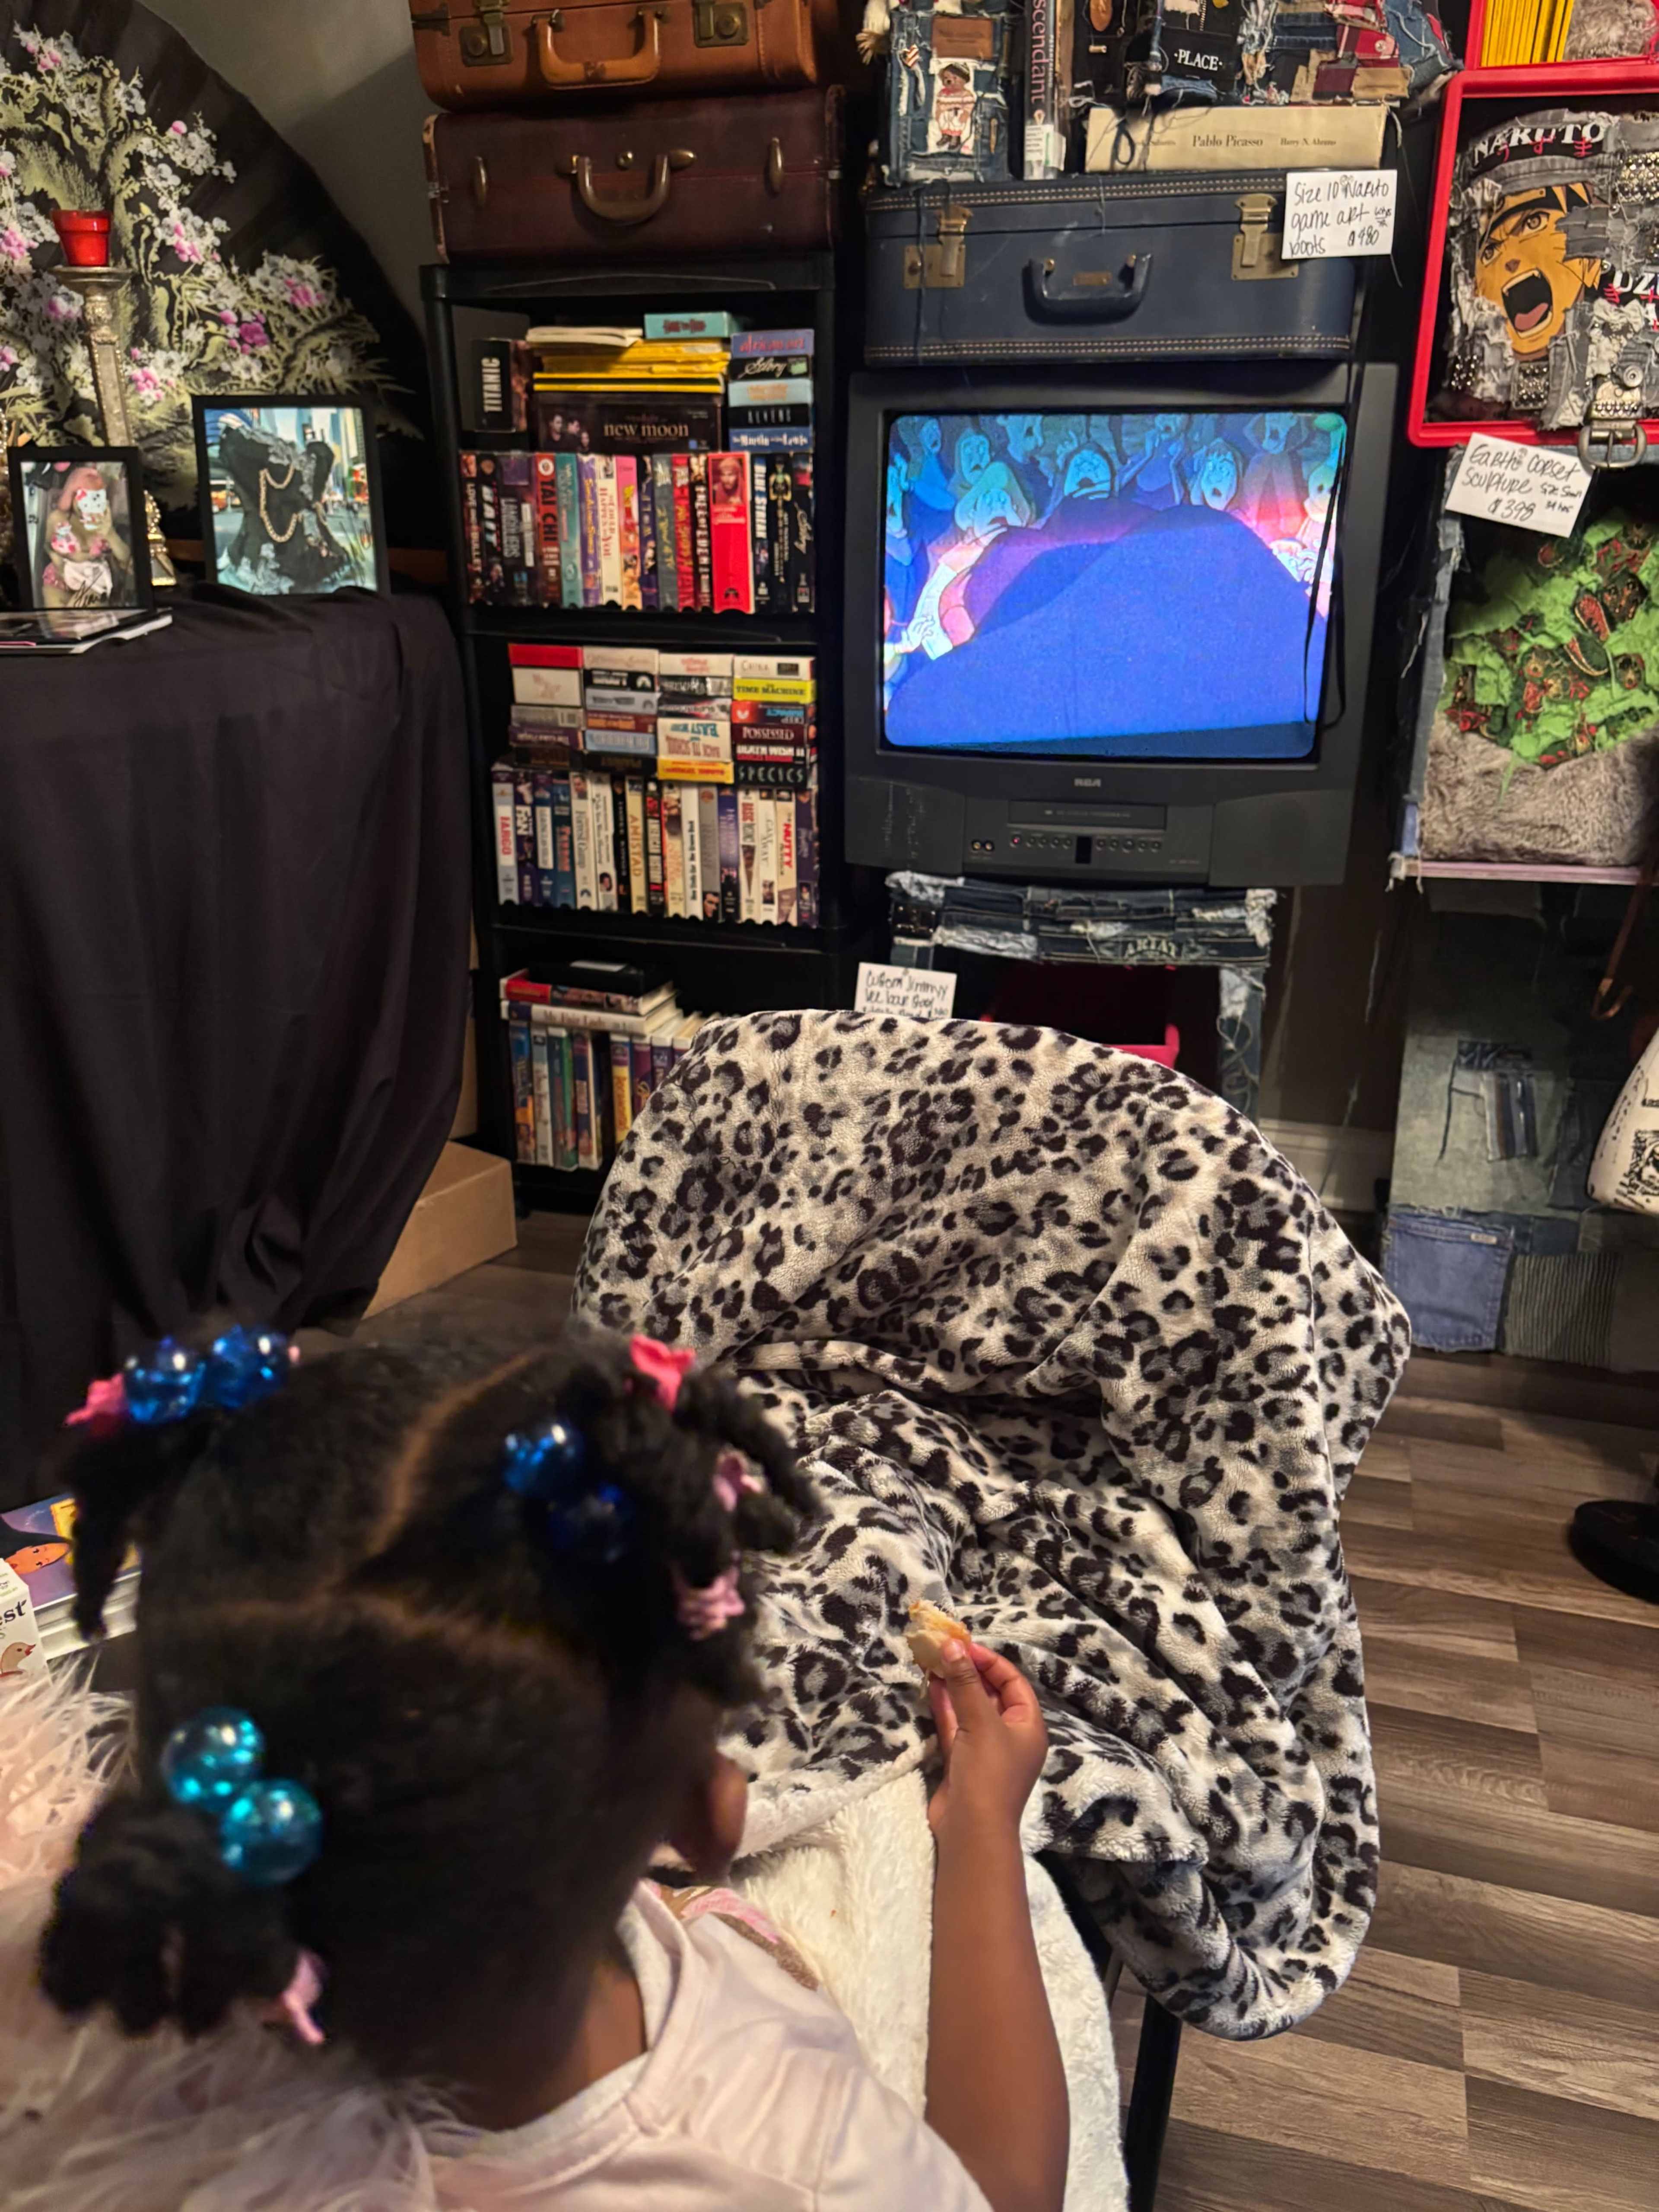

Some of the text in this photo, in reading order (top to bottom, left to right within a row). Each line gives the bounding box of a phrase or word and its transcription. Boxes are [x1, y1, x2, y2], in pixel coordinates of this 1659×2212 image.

[1177, 48, 1219, 71] PLACE
[1192, 134, 1264, 147] Pablo Picasso
[1474, 123, 1607, 166] NARUTO
[1294, 181, 1322, 206] Size
[1327, 181, 1339, 201] 10
[1291, 209, 1331, 242] game
[1289, 234, 1326, 257] boots
[481, 357, 503, 413] TITANIC
[604, 423, 689, 437] new moon
[540, 479, 558, 506] TAI
[753, 465, 768, 539] BLUE STREAK
[542, 512, 558, 542] CHI
[742, 726, 795, 741] POSSESSED
[738, 765, 804, 783] SPECIES
[1074, 778, 1101, 787] RCA
[499, 815, 512, 855] FARGO
[629, 814, 642, 877] AMISTAD
[782, 823, 792, 869] NUTTY
[0, 1599, 27, 1626] st
